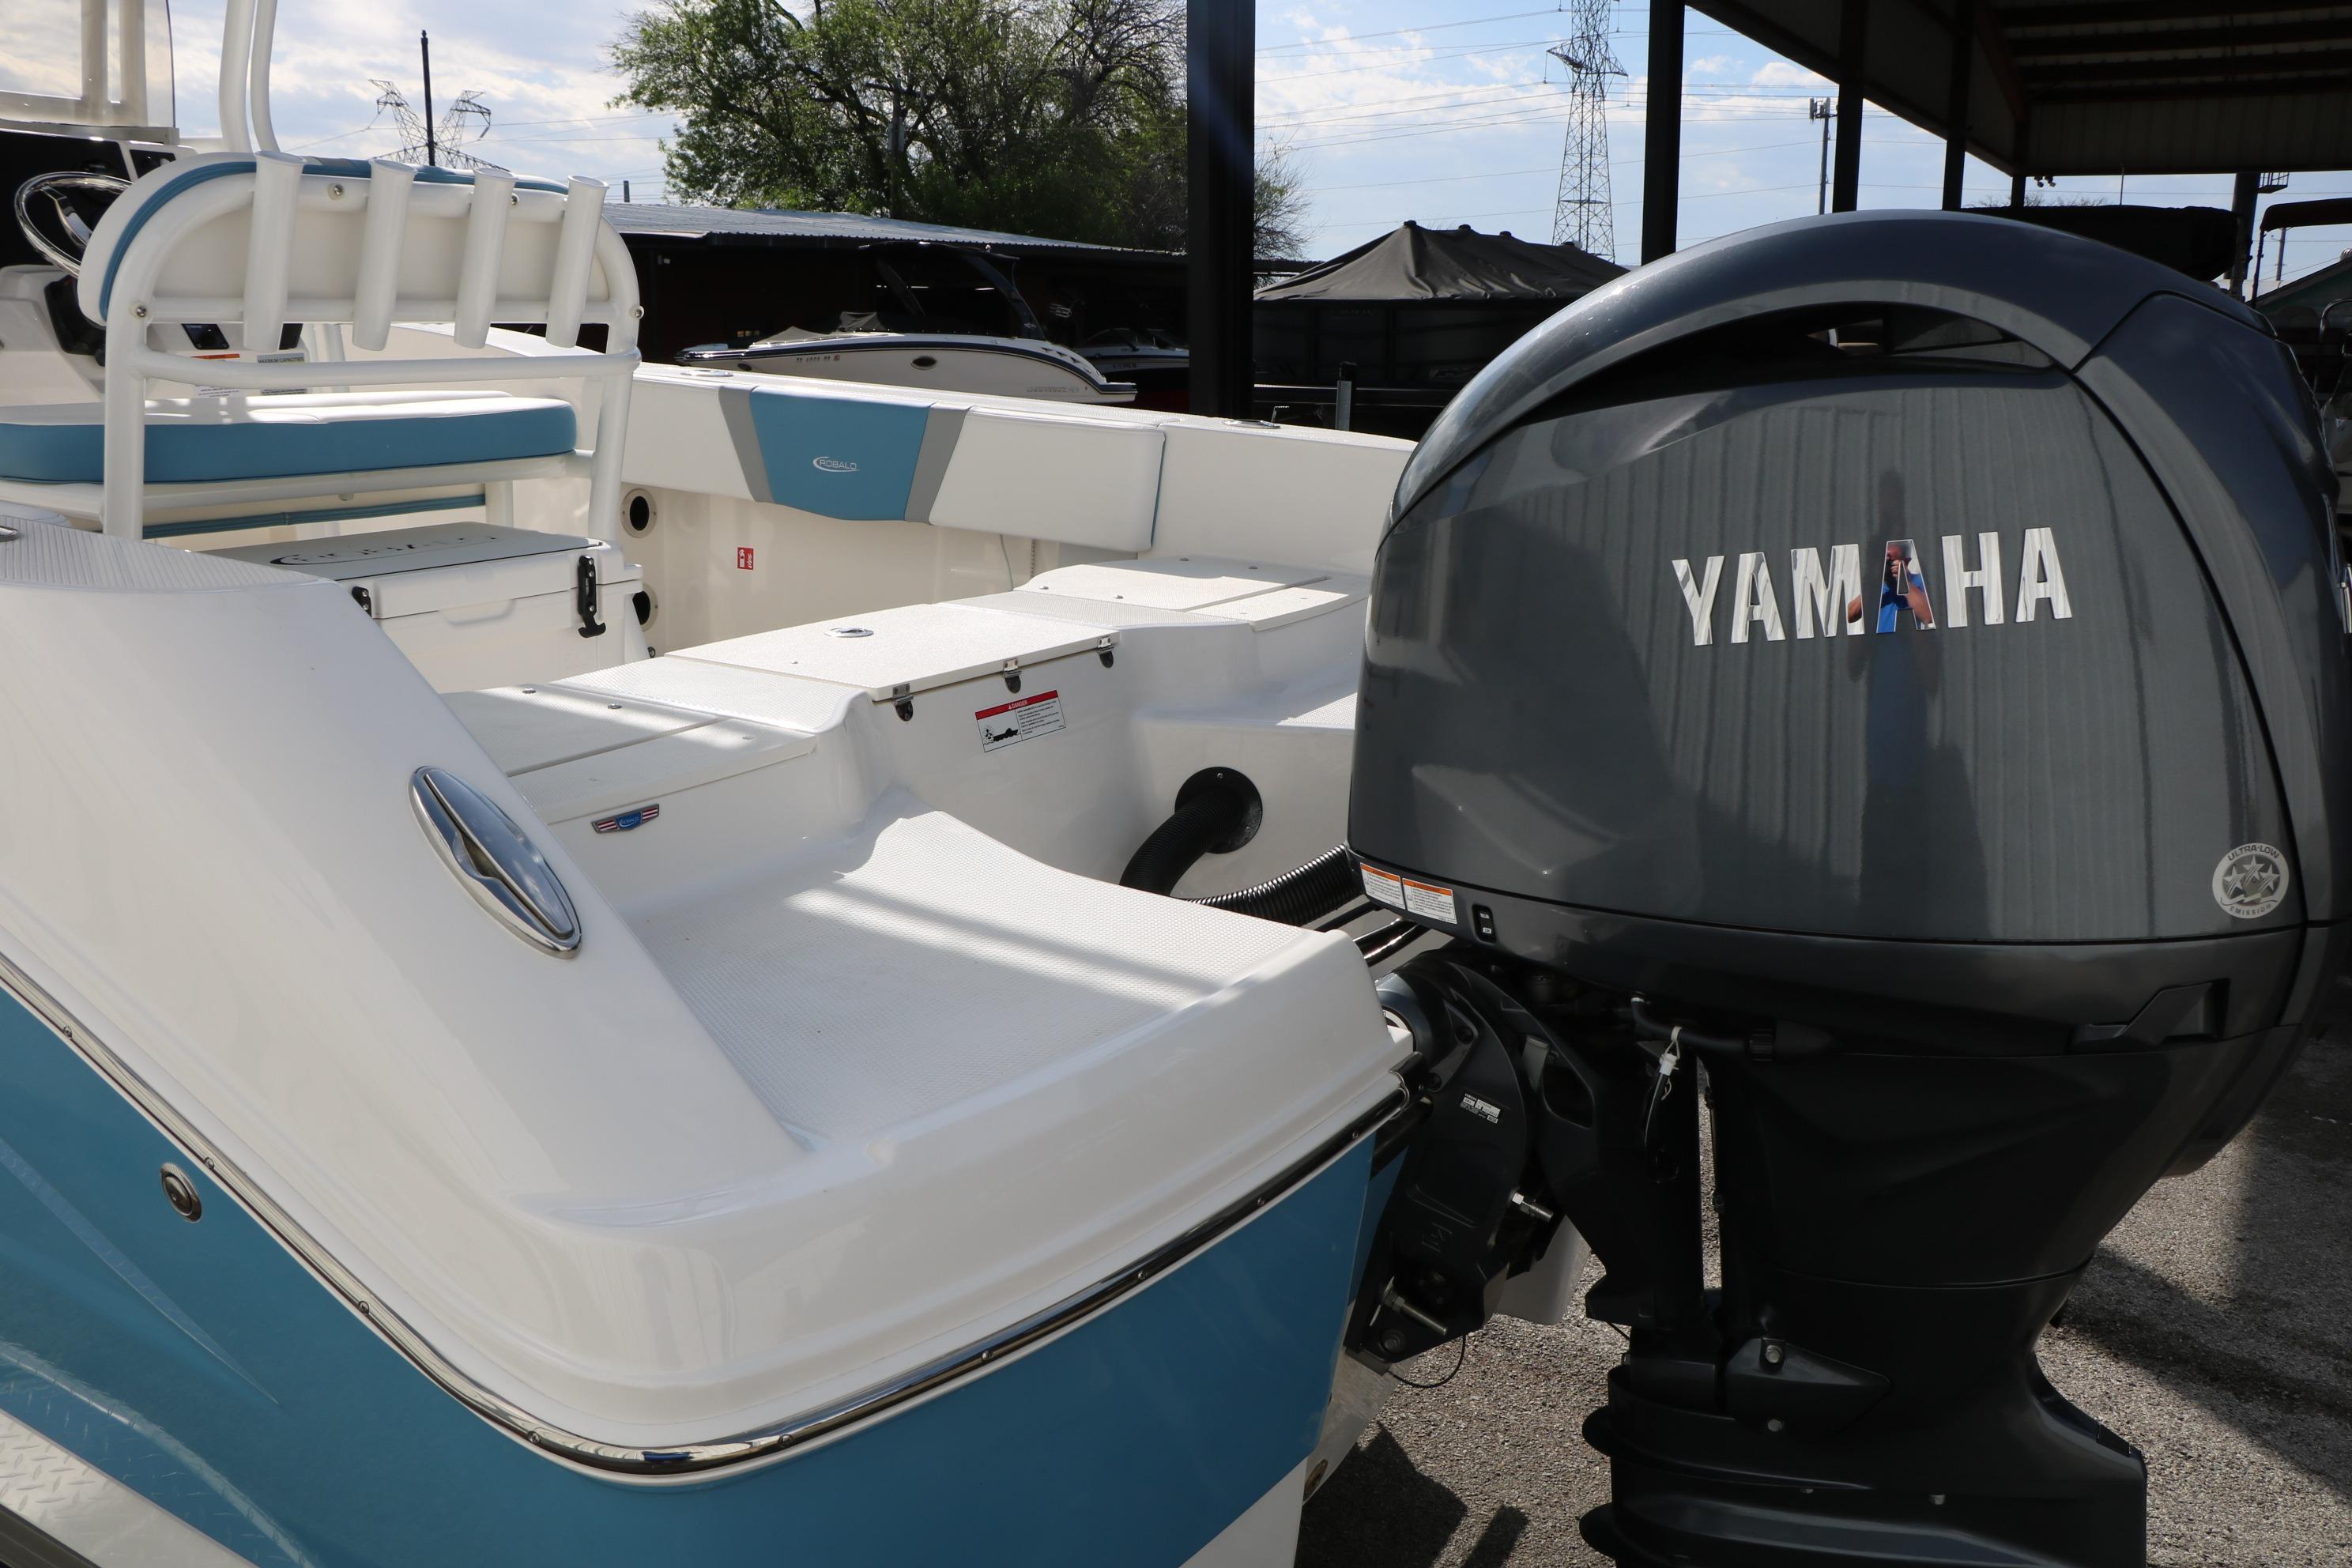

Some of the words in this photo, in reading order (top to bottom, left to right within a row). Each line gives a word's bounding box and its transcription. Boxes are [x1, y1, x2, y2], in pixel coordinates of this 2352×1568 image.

[819, 459, 858, 470] ROBALO
[1672, 527, 2072, 646] YAMAHA
[1012, 700, 1028, 709] DANGER
[2229, 903, 2271, 916] EMISSION
